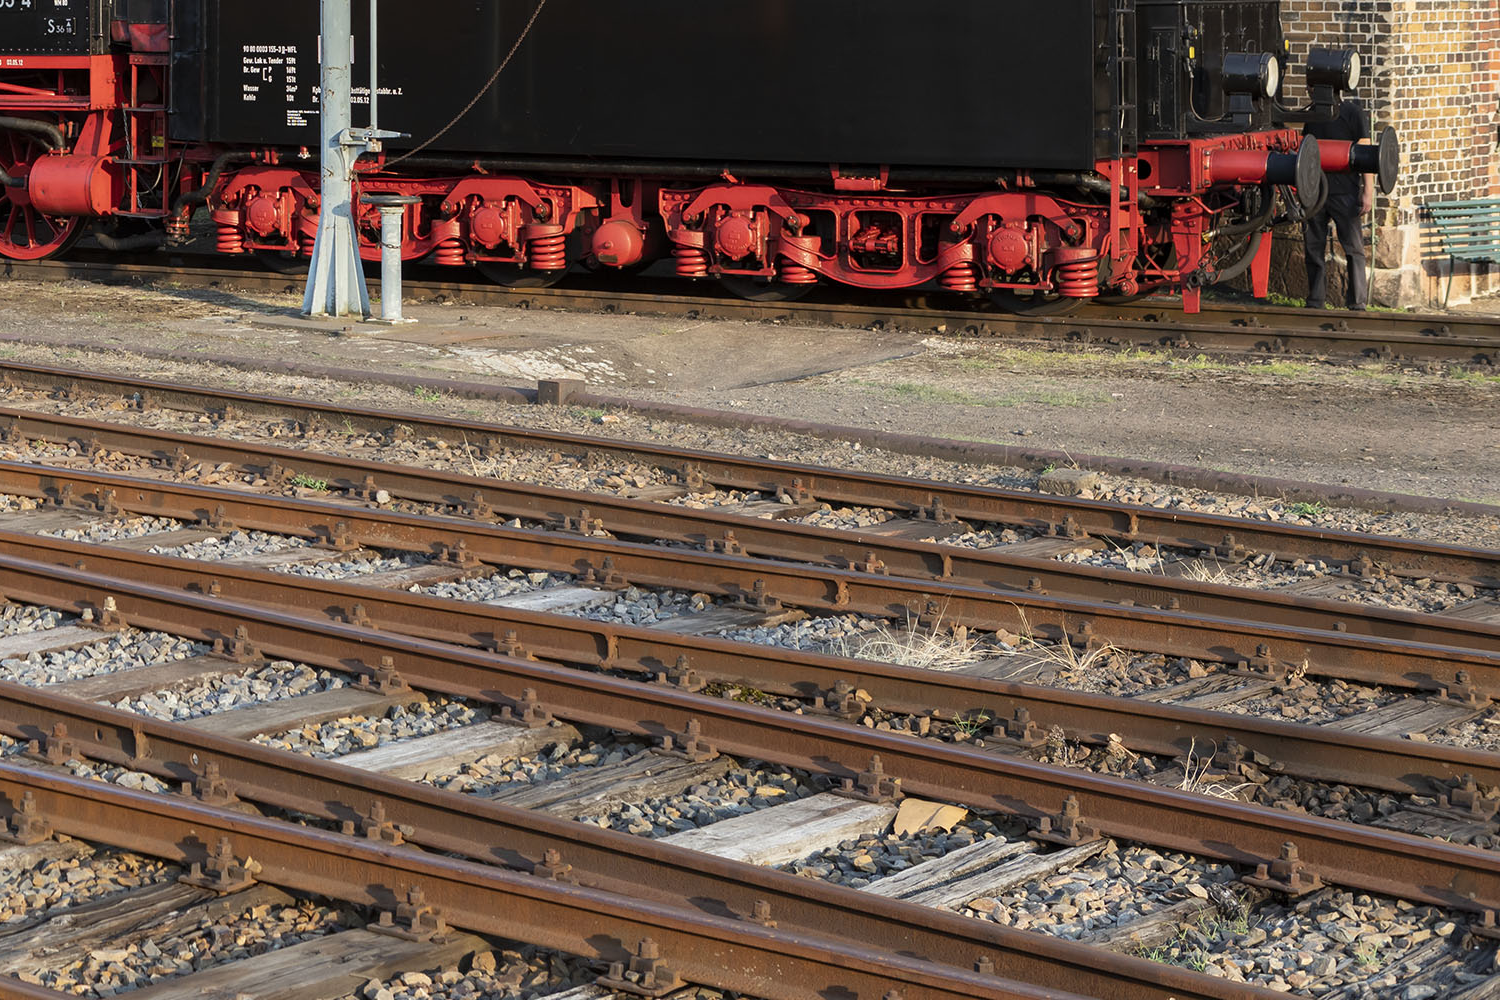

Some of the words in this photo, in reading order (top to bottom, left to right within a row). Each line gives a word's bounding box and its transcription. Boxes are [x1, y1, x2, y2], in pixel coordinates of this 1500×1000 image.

[47, 18, 55, 34] S
[56, 24, 65, 34] 36
[243, 84, 259, 92] Wasser
[243, 93, 256, 101] Kohle
